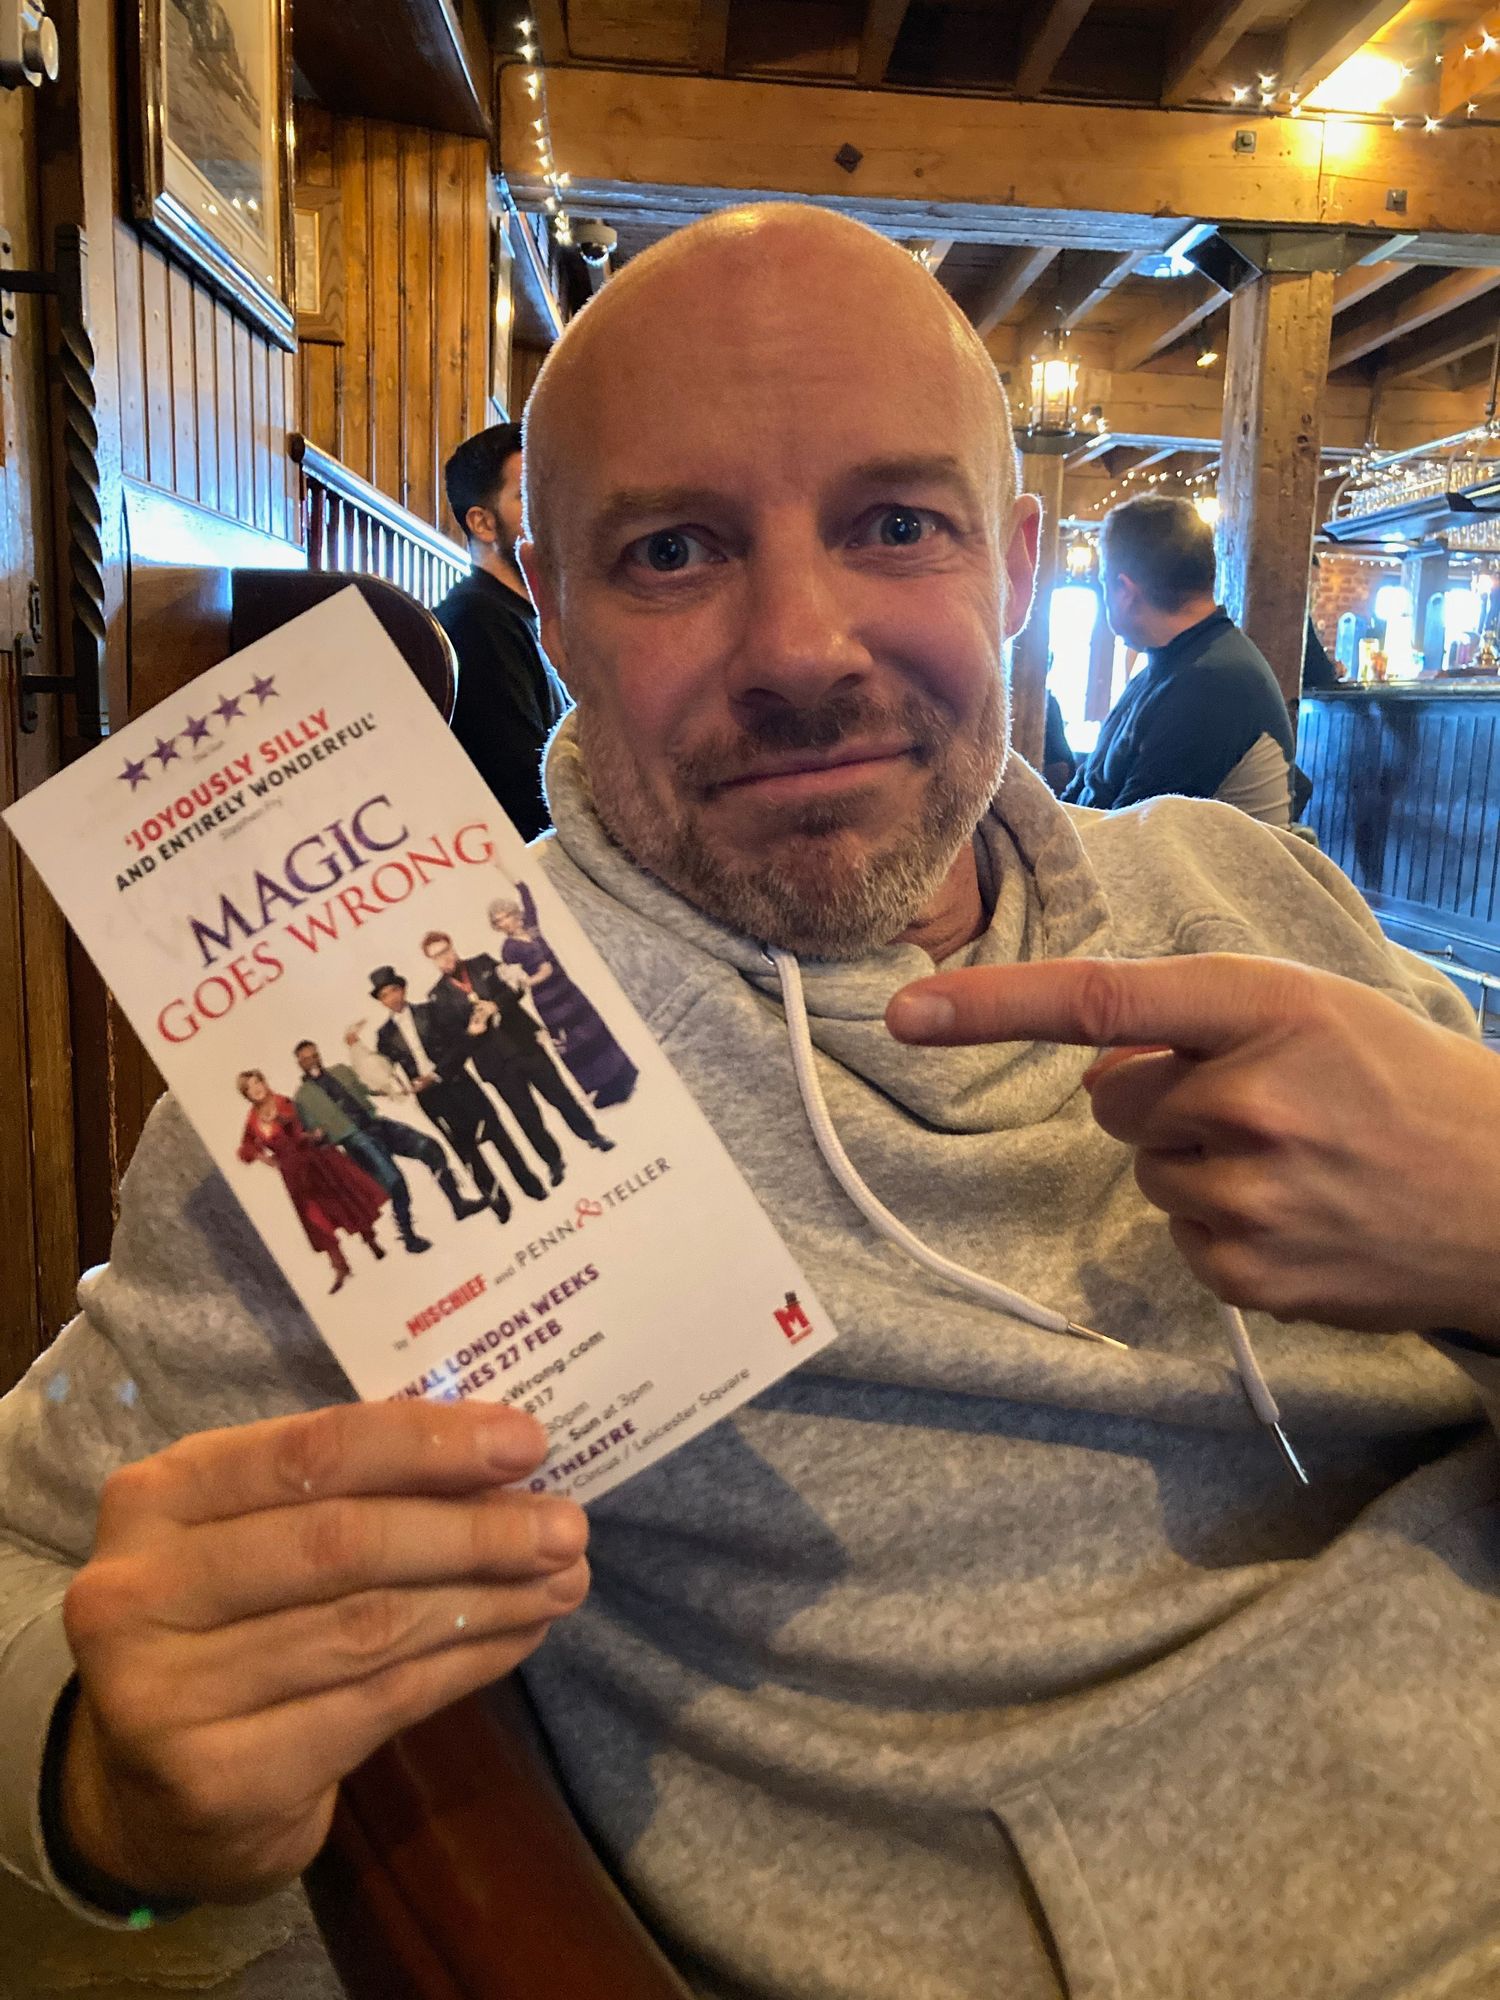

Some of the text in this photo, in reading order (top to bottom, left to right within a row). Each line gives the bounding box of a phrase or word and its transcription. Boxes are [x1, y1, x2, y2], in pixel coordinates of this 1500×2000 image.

[257, 707, 331, 764] SILLY
[115, 855, 157, 892] AND
[157, 790, 247, 861] ENTIRELY
[187, 794, 409, 967] MAGIC
[157, 823, 494, 1044] GOES WRONG
[406, 1273, 487, 1338] MISCHIEF
[515, 1218, 576, 1267] PENN
[575, 1197, 603, 1229] &
[602, 1157, 672, 1208] TELLER
[445, 1309, 532, 1373] LONDON
[530, 1263, 600, 1316] WEEKS
[495, 1344, 520, 1371] 27
[524, 1318, 562, 1351] FEB
[500, 1331, 605, 1406] sWrong.com
[524, 1386, 553, 1414] 817
[546, 1400, 590, 1435] 30pm
[568, 1380, 654, 1441] Sun at 3pm
[632, 1403, 697, 1450] Leicester
[699, 1368, 751, 1406] Square
[548, 1418, 637, 1481] THEATRE
